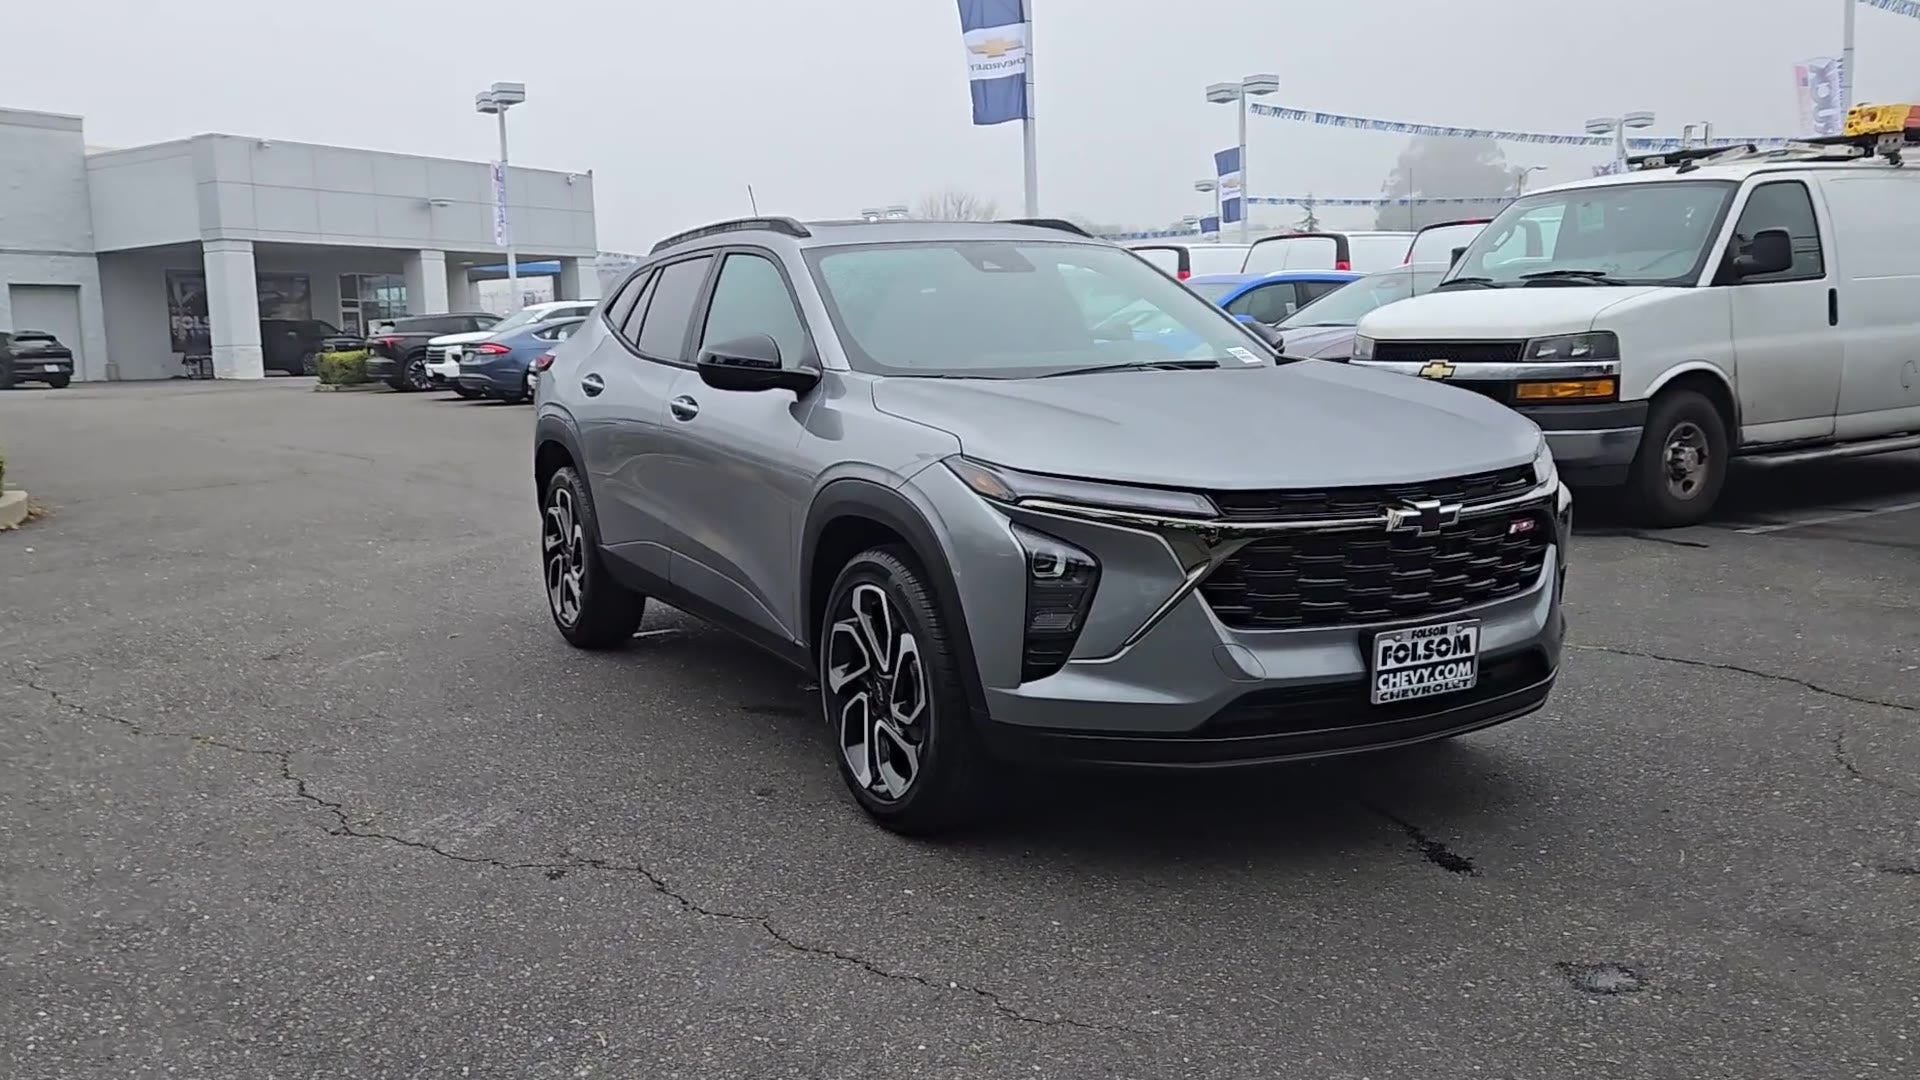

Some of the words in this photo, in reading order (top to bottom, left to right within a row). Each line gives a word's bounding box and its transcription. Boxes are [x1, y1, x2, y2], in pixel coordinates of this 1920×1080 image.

[1412, 625, 1448, 639] FOLSOM
[1381, 634, 1471, 666] FOLSOM
[1378, 661, 1471, 690] CHEVY.COM
[1380, 679, 1471, 701] CHEVROLET
